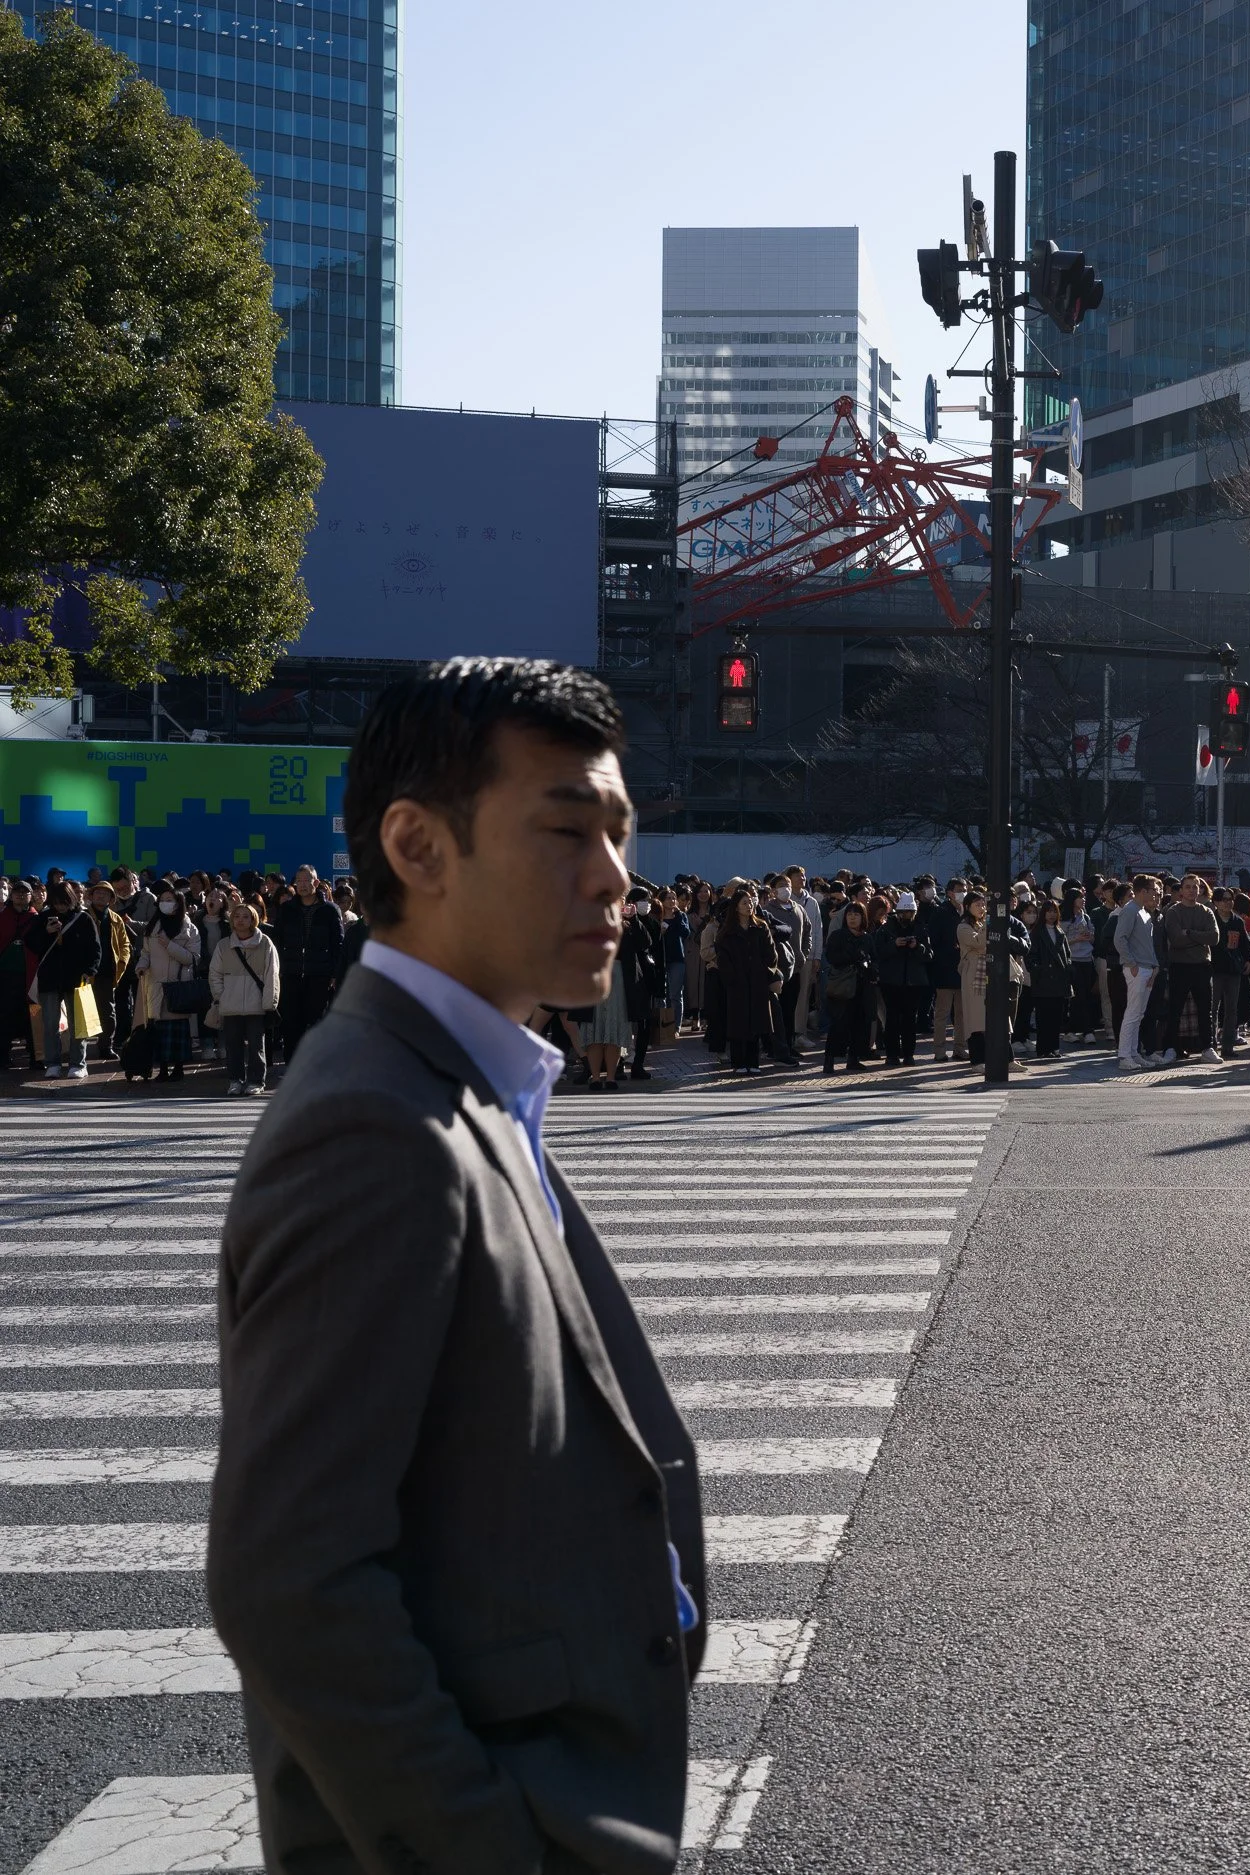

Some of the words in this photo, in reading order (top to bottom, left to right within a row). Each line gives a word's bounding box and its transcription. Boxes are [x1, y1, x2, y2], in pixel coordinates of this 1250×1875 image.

[86, 751, 169, 762] #DIGSHIBUYA
[269, 755, 308, 779] 20
[269, 782, 307, 805] 24
